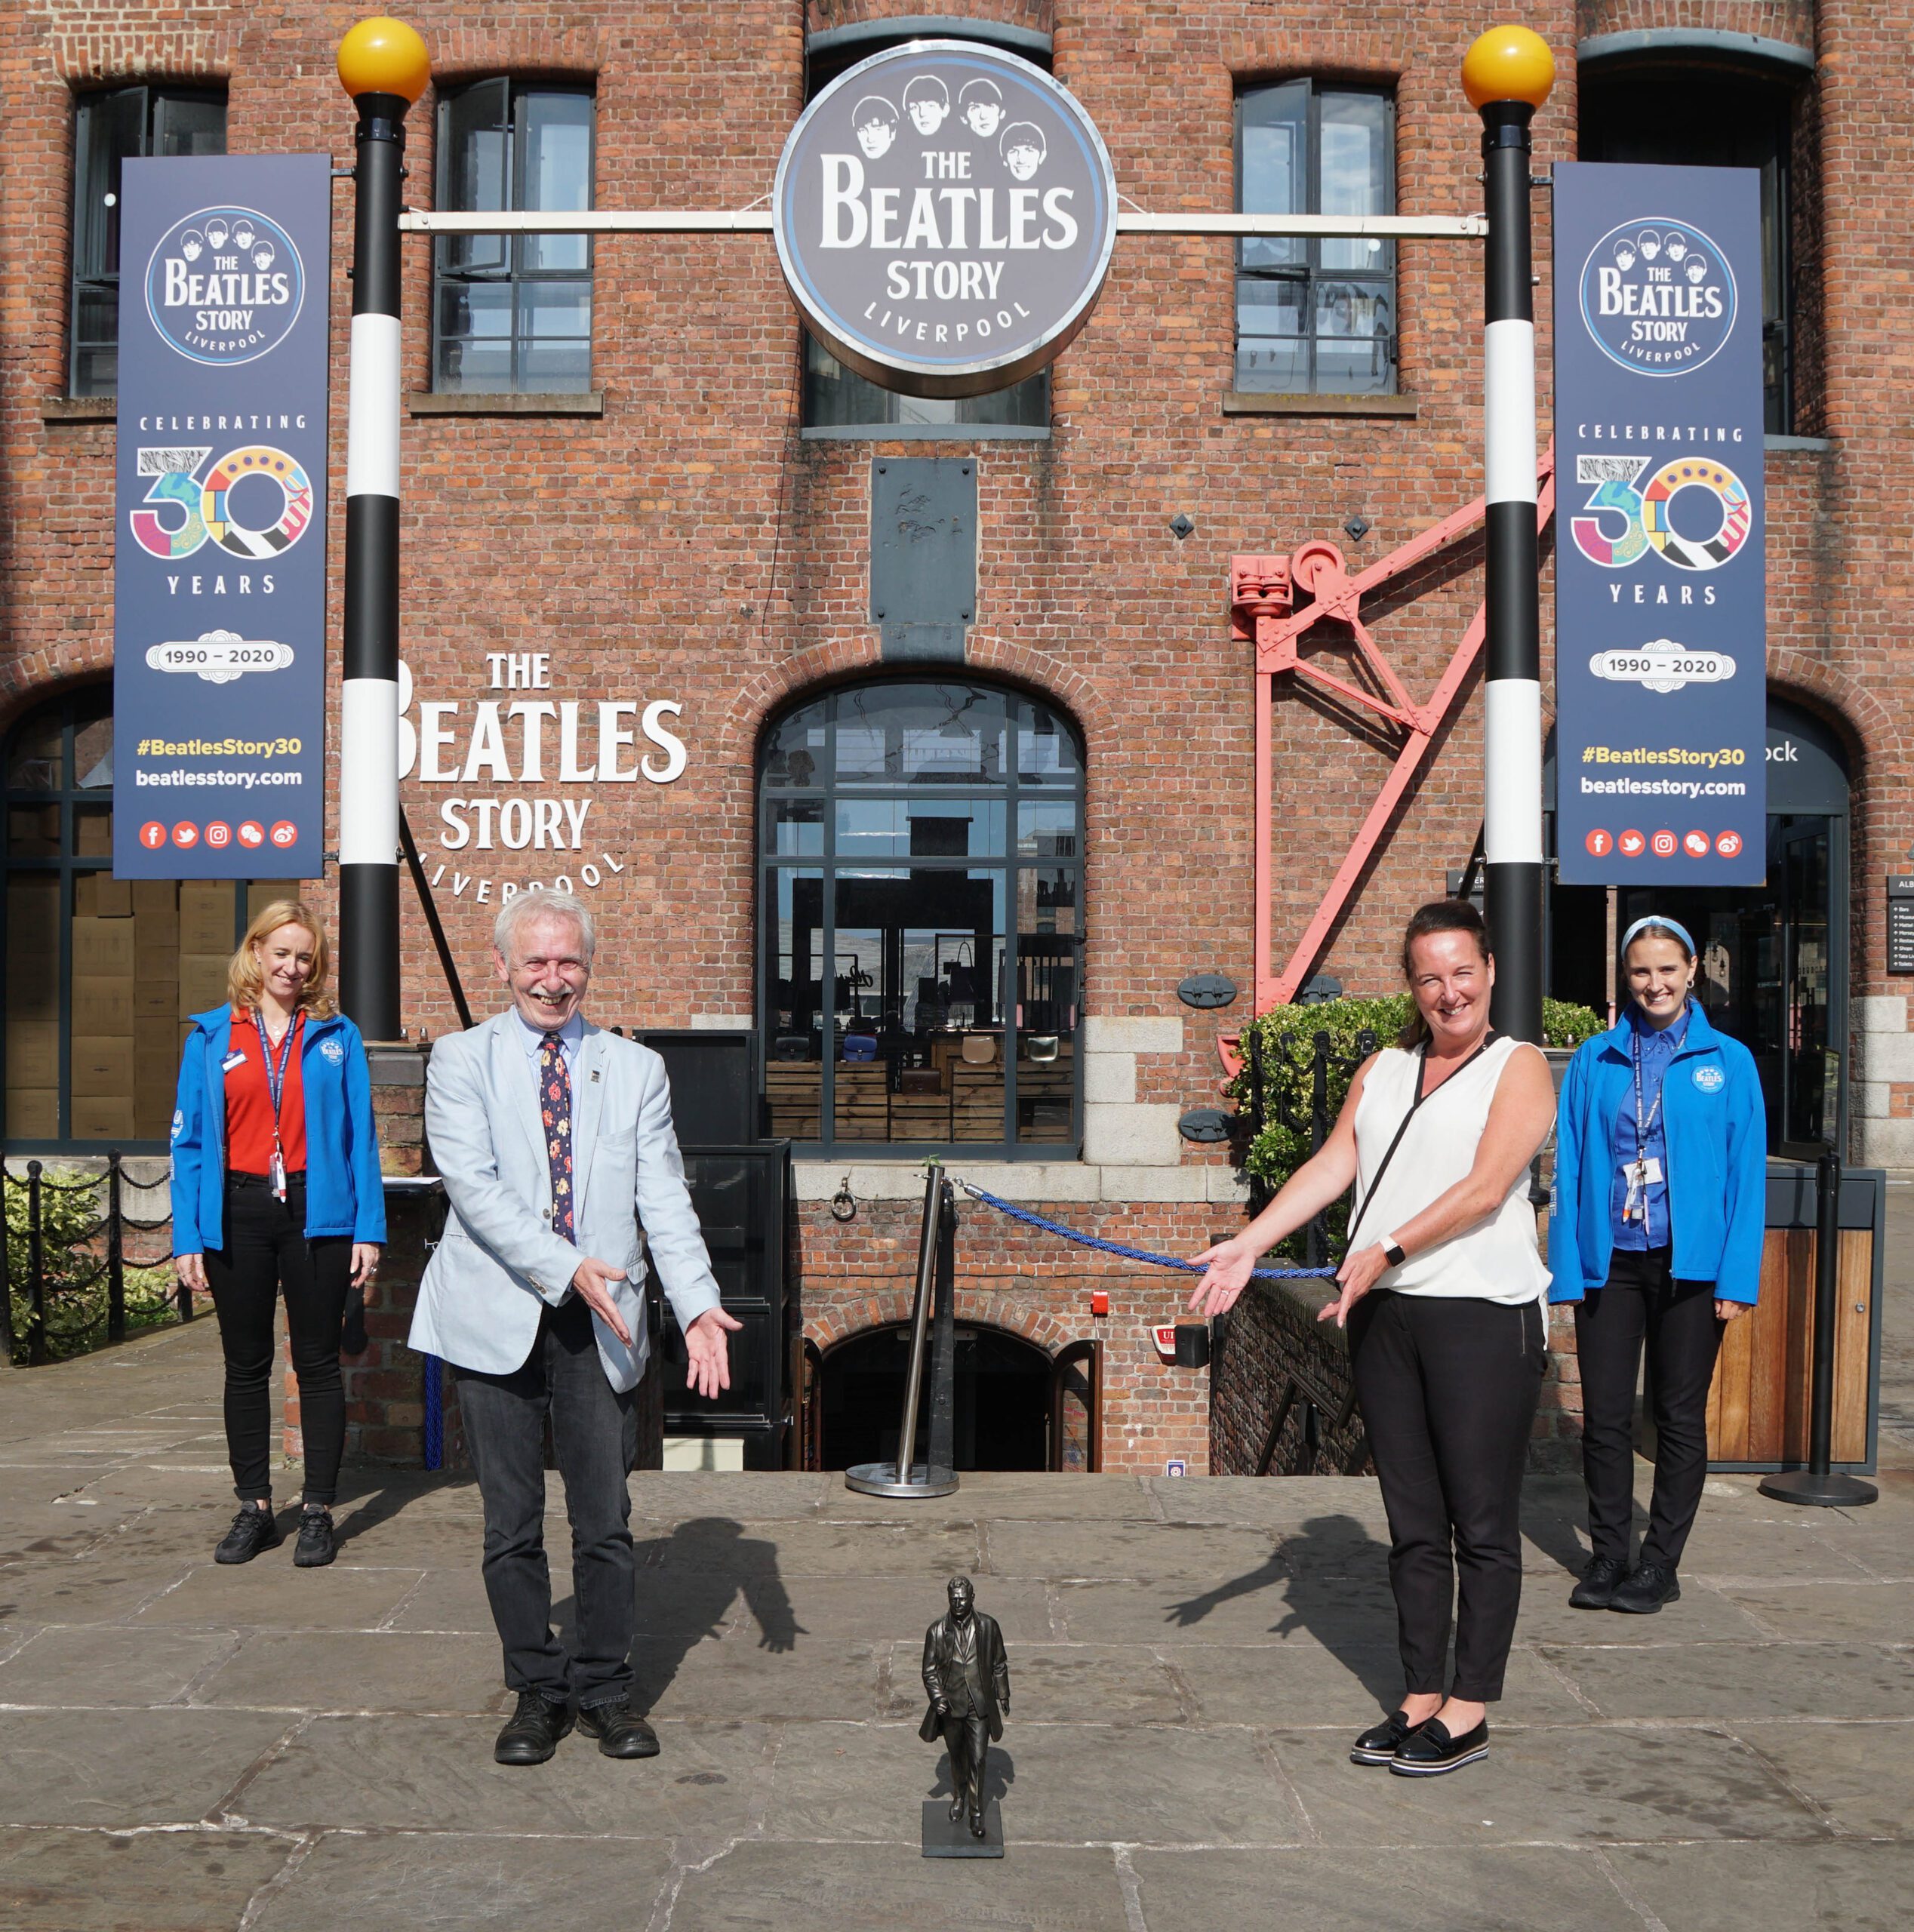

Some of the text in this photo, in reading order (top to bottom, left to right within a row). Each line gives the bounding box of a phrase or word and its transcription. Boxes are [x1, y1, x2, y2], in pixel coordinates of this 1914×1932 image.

[921, 152, 971, 179] THE
[819, 153, 1079, 250] BEATLES
[214, 256, 238, 271] THE
[1647, 267, 1672, 282] THE
[164, 258, 290, 306] BEATLES
[887, 260, 1005, 300] STORY
[1599, 267, 1723, 318] BEATLES
[195, 310, 254, 331] STORY
[863, 301, 1030, 343] LIVERPOOL
[1631, 320, 1688, 342] STORY
[184, 329, 266, 352] LIVERPOOL
[1621, 340, 1700, 362] LIVERPOOL
[140, 415, 306, 431] CELEBRATING
[1578, 424, 1742, 442] CELEBRATING
[130, 445, 313, 560] 30
[1571, 454, 1752, 571] 30
[167, 575, 275, 595] YEARS
[1610, 584, 1716, 605] YEARS
[165, 651, 208, 663] 1990
[229, 650, 275, 663] 2020
[1608, 659, 1651, 671] 1990
[1672, 660, 1716, 673] 2020
[486, 653, 550, 690] THE
[137, 738, 302, 758] #BeatlesStory30
[1582, 746, 1745, 768] #BeatlesStory30
[136, 769, 303, 789] beatlesstory.com
[1581, 777, 1746, 799] beatlesstory.com
[440, 798, 592, 851] STORY
